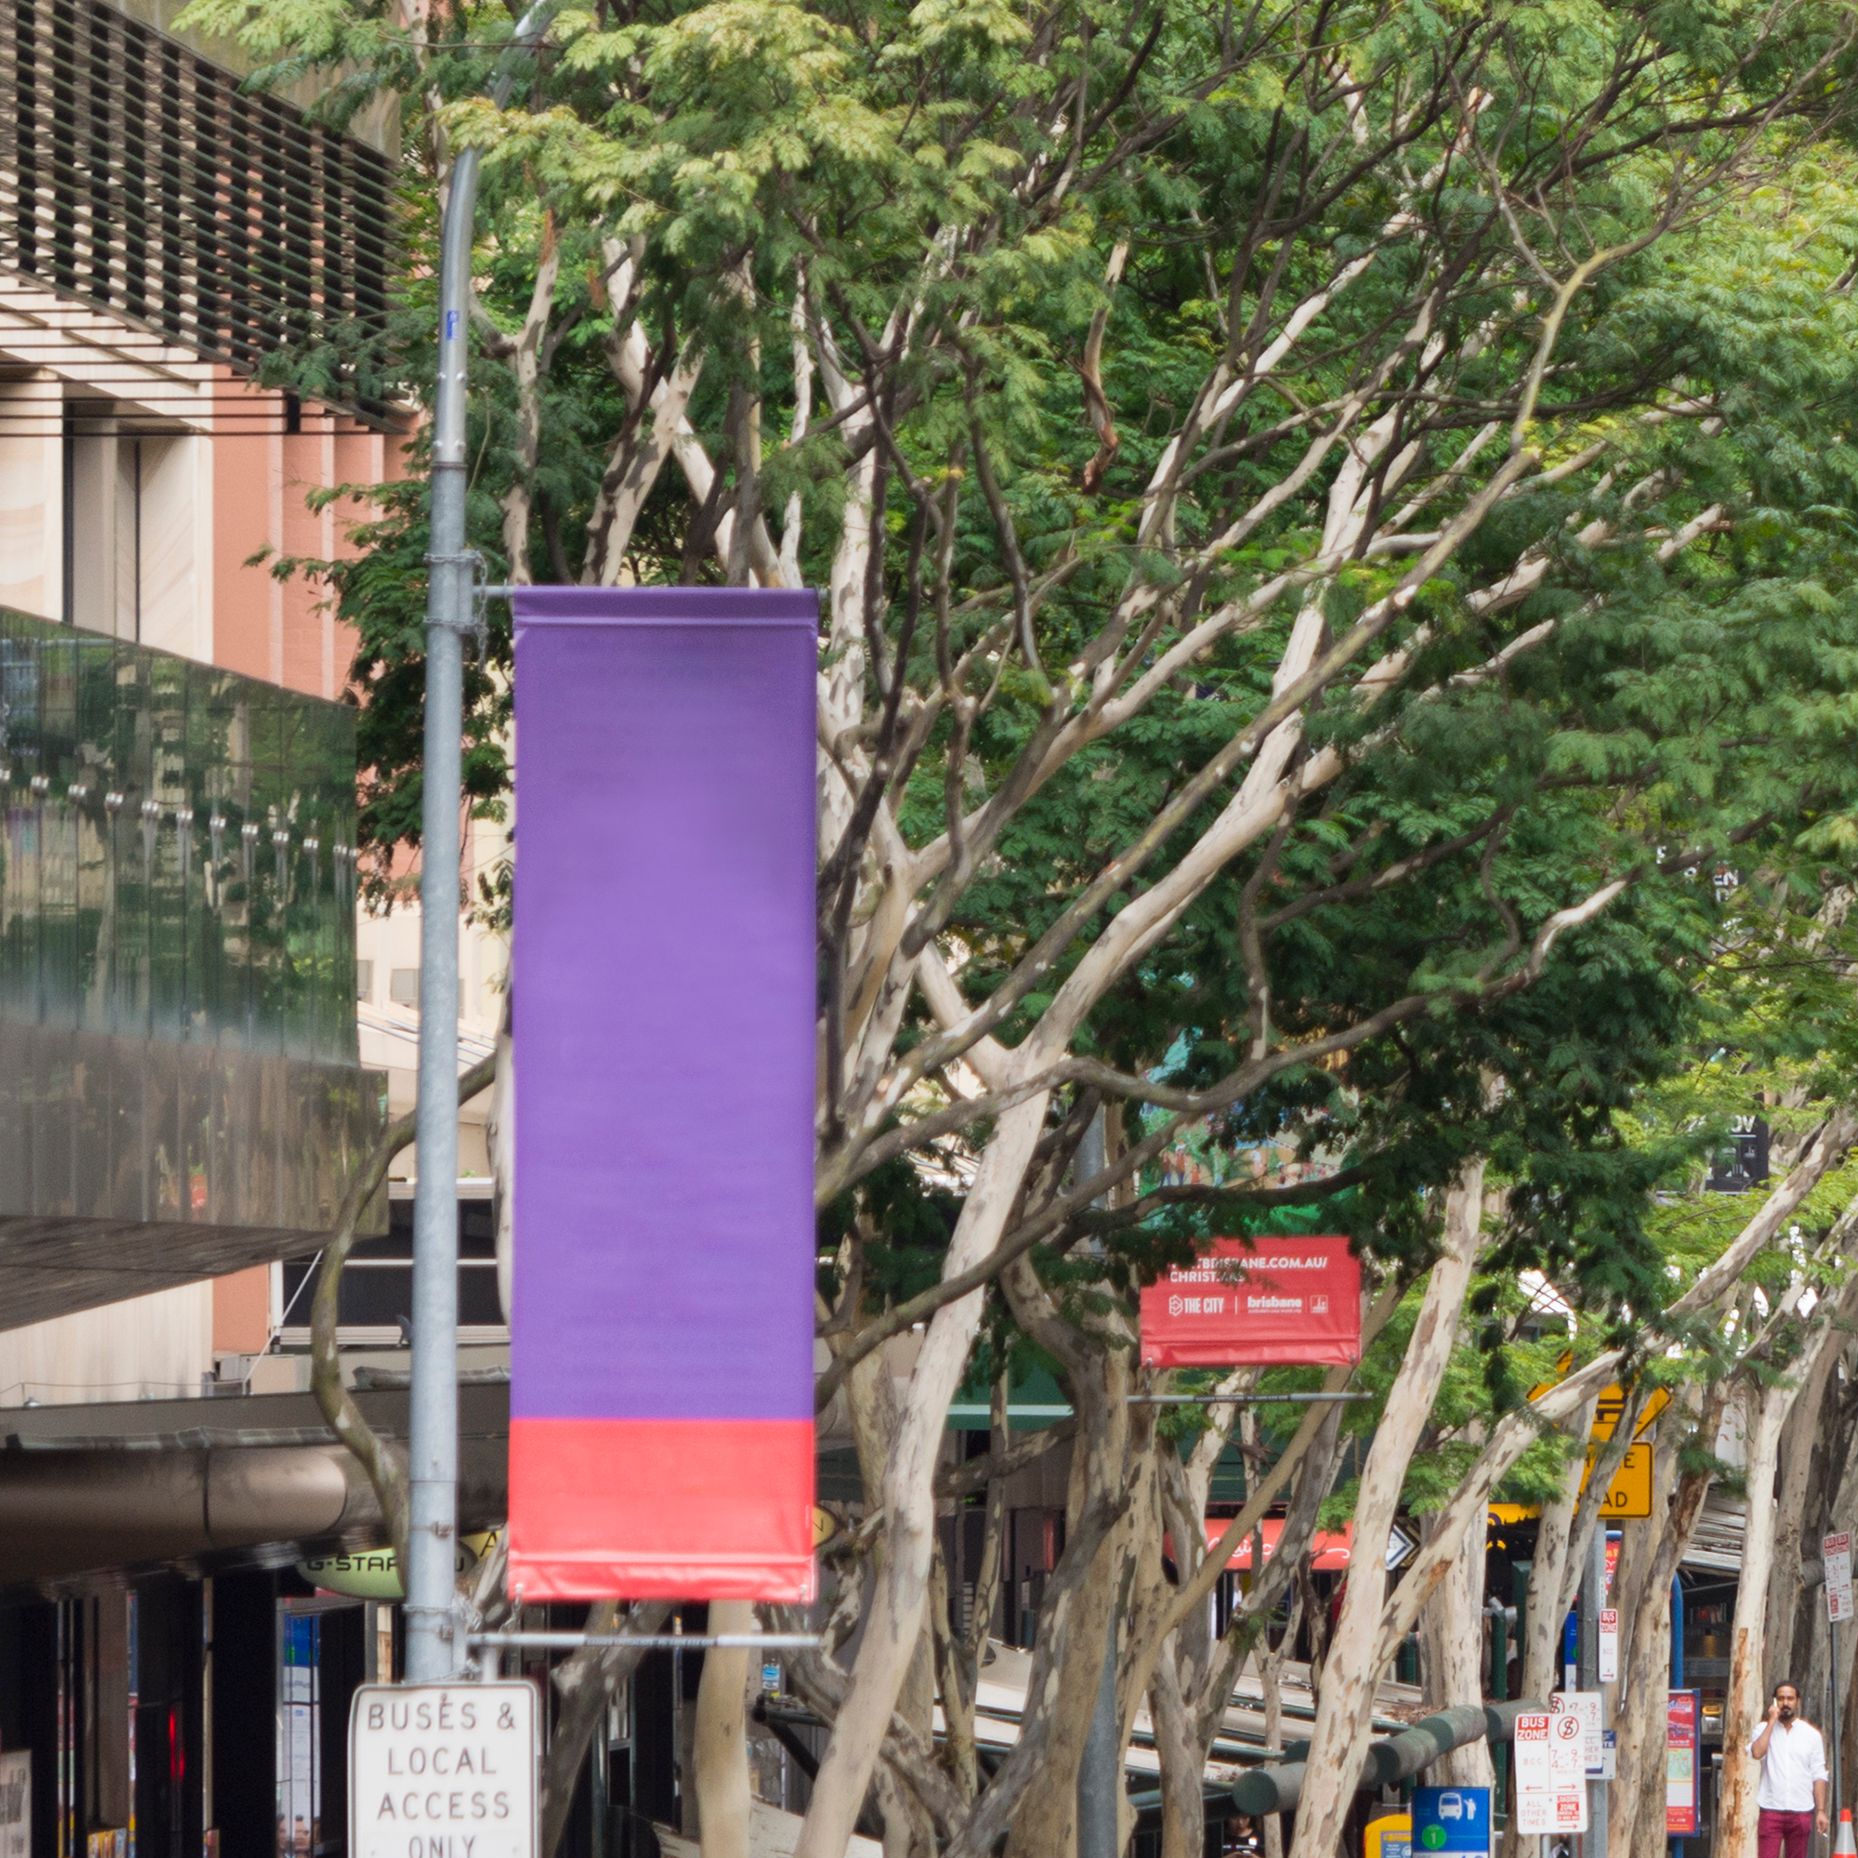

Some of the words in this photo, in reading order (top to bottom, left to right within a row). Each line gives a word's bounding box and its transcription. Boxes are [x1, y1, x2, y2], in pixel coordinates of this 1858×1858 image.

[1184, 1297, 1201, 1313] THE
[1203, 1297, 1224, 1313] CITY
[1247, 1295, 1303, 1309] brisbane
[367, 1701, 477, 1731] BUSES
[497, 1701, 516, 1731] &
[1521, 1717, 1545, 1728] BUS
[1518, 1730, 1548, 1740] ZONE
[388, 1748, 497, 1775] LOCAL
[377, 1792, 510, 1820] ACCESS
